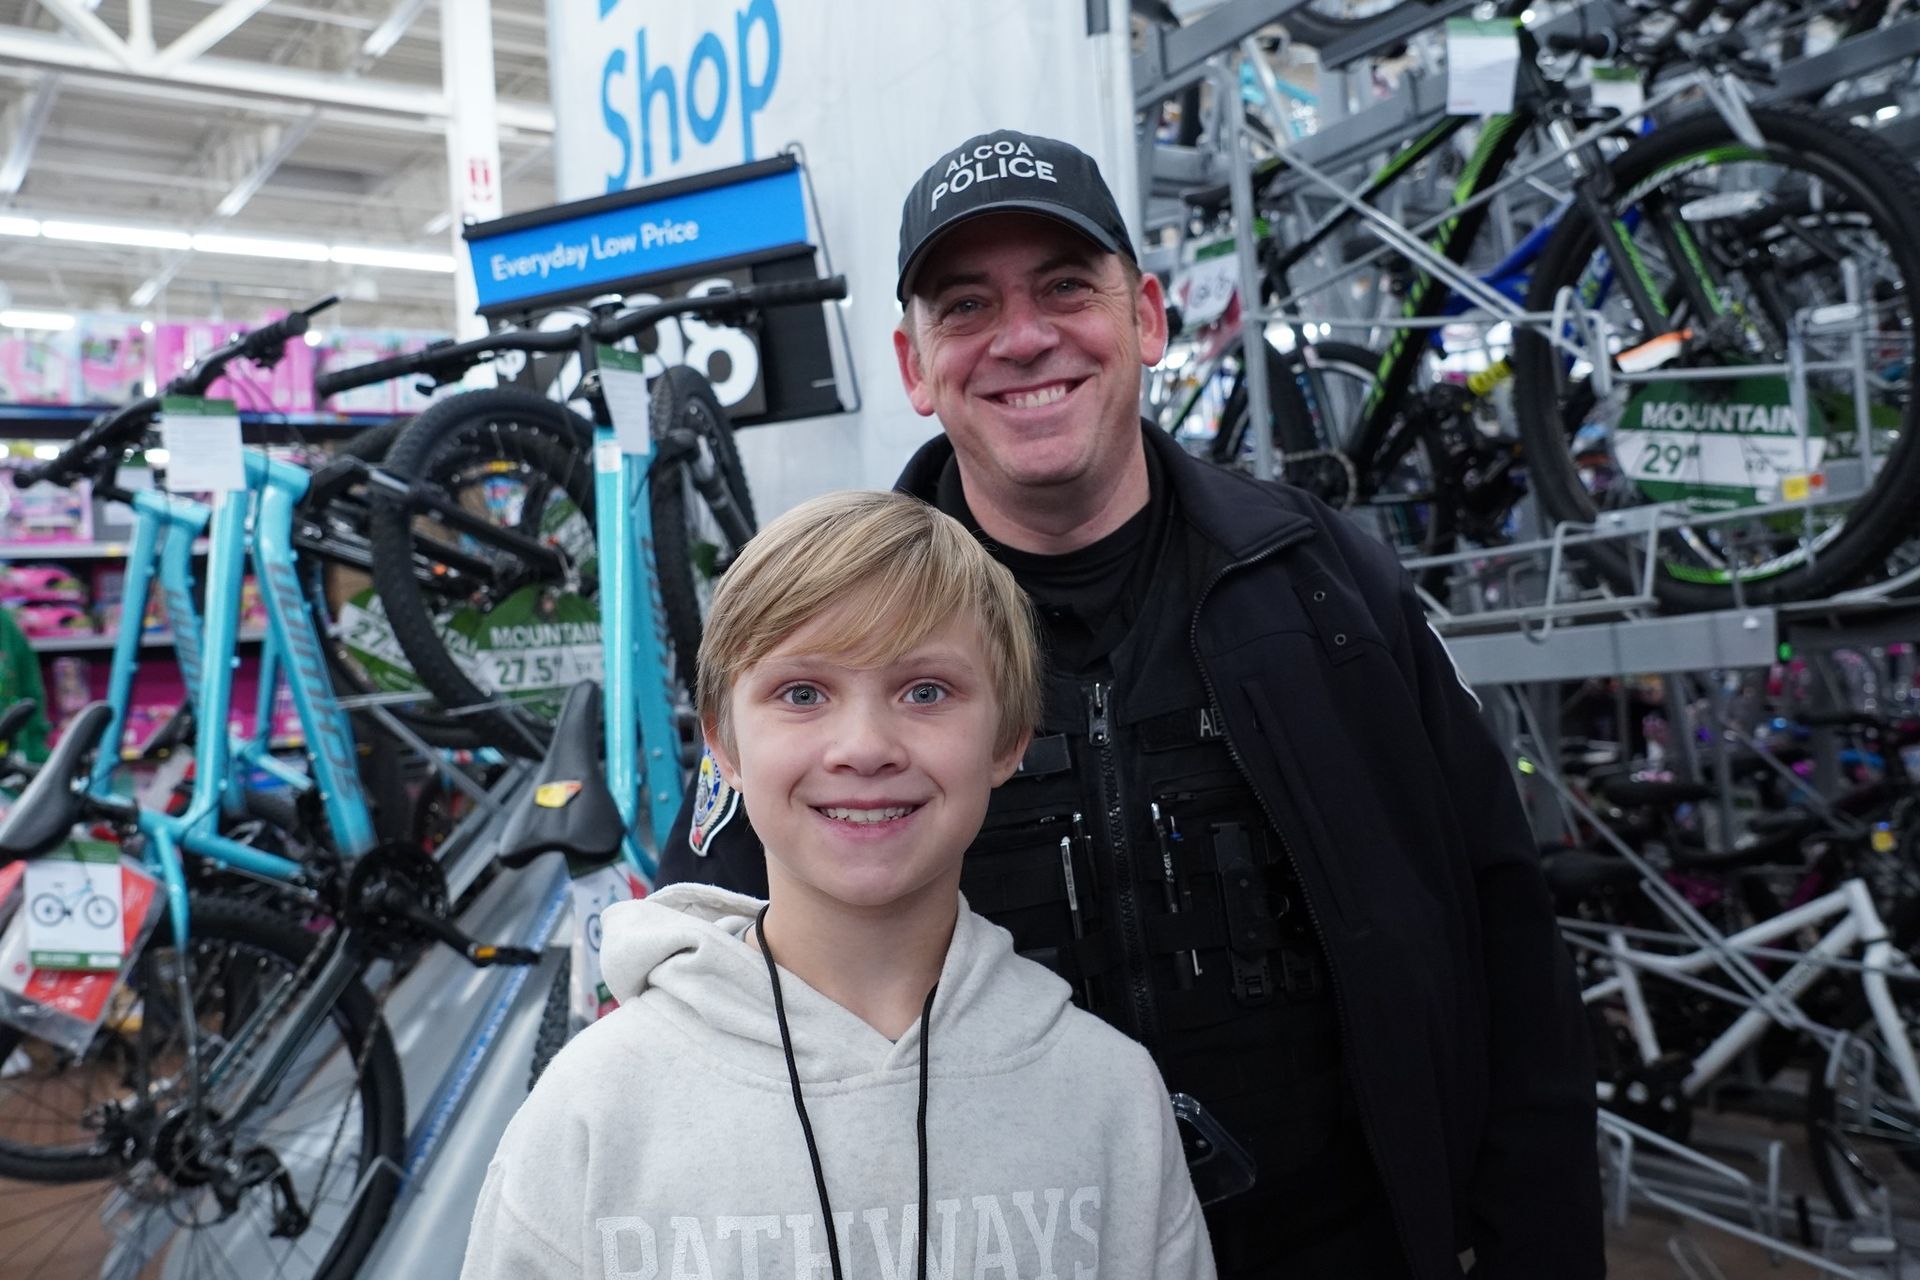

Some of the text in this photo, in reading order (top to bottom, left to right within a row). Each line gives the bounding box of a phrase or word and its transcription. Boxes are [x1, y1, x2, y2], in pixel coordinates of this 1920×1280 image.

[931, 157, 1058, 212] POLICE
[945, 141, 1034, 178] ALCOA
[490, 219, 699, 281] Everyday Low Price
[596, 1185, 1102, 1280] PATHWAYS
